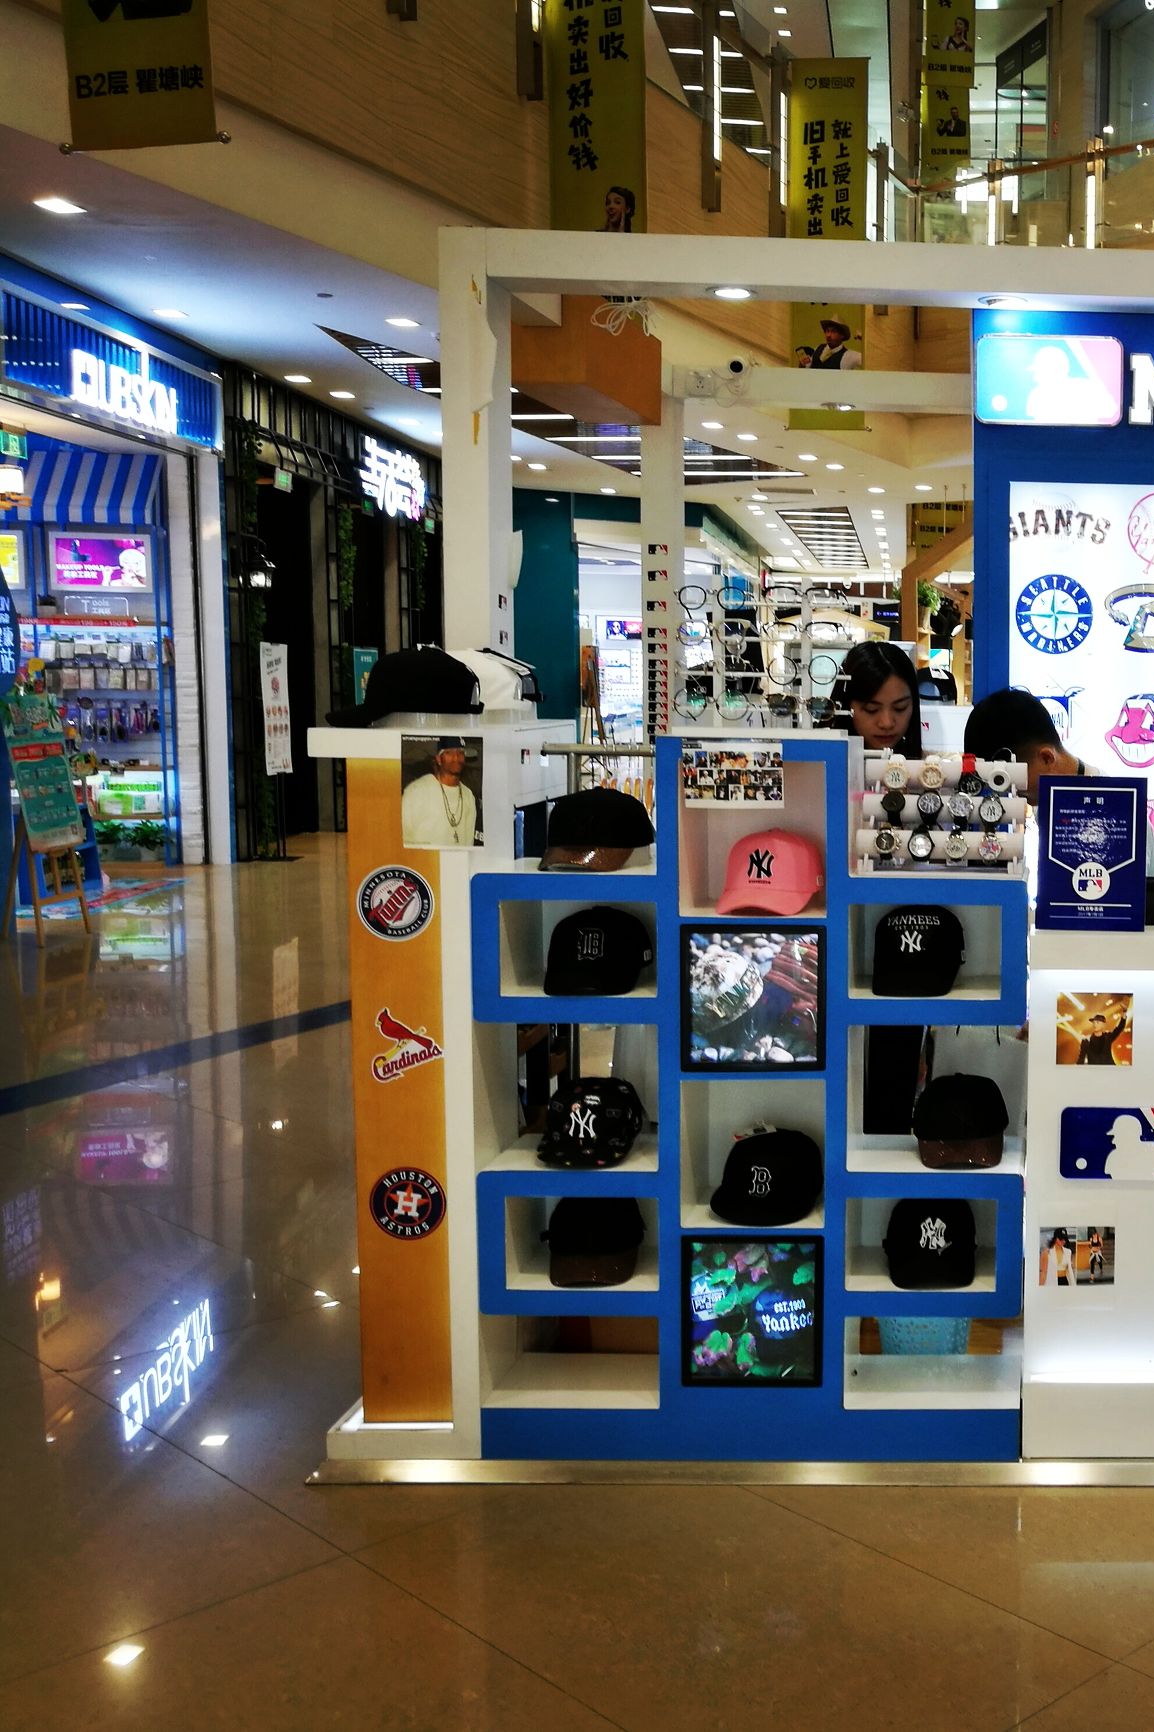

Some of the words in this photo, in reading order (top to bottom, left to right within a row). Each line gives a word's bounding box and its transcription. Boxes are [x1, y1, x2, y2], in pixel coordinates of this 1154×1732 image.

[598, 0, 629, 62] 回收
[75, 71, 129, 99] B2层
[136, 64, 204, 94] 瞿塘峡
[803, 120, 828, 237] 旧手机卖出
[831, 119, 853, 229] 就上爱回收
[1021, 576, 1089, 607] SEATTLE
[747, 848, 774, 879] NY
[1079, 868, 1103, 878] MLB
[363, 871, 407, 909] MINNESOTA
[367, 877, 417, 929] Twins
[387, 919, 423, 936] BASEBALL
[887, 914, 941, 926] YANKEES
[900, 930, 923, 953] NY
[373, 1046, 442, 1080] Cardinals
[569, 1109, 596, 1139] NY
[383, 1171, 439, 1195] HOUSTON
[749, 1165, 772, 1198] B
[394, 1190, 423, 1217] H
[380, 1216, 430, 1236] ASTROS
